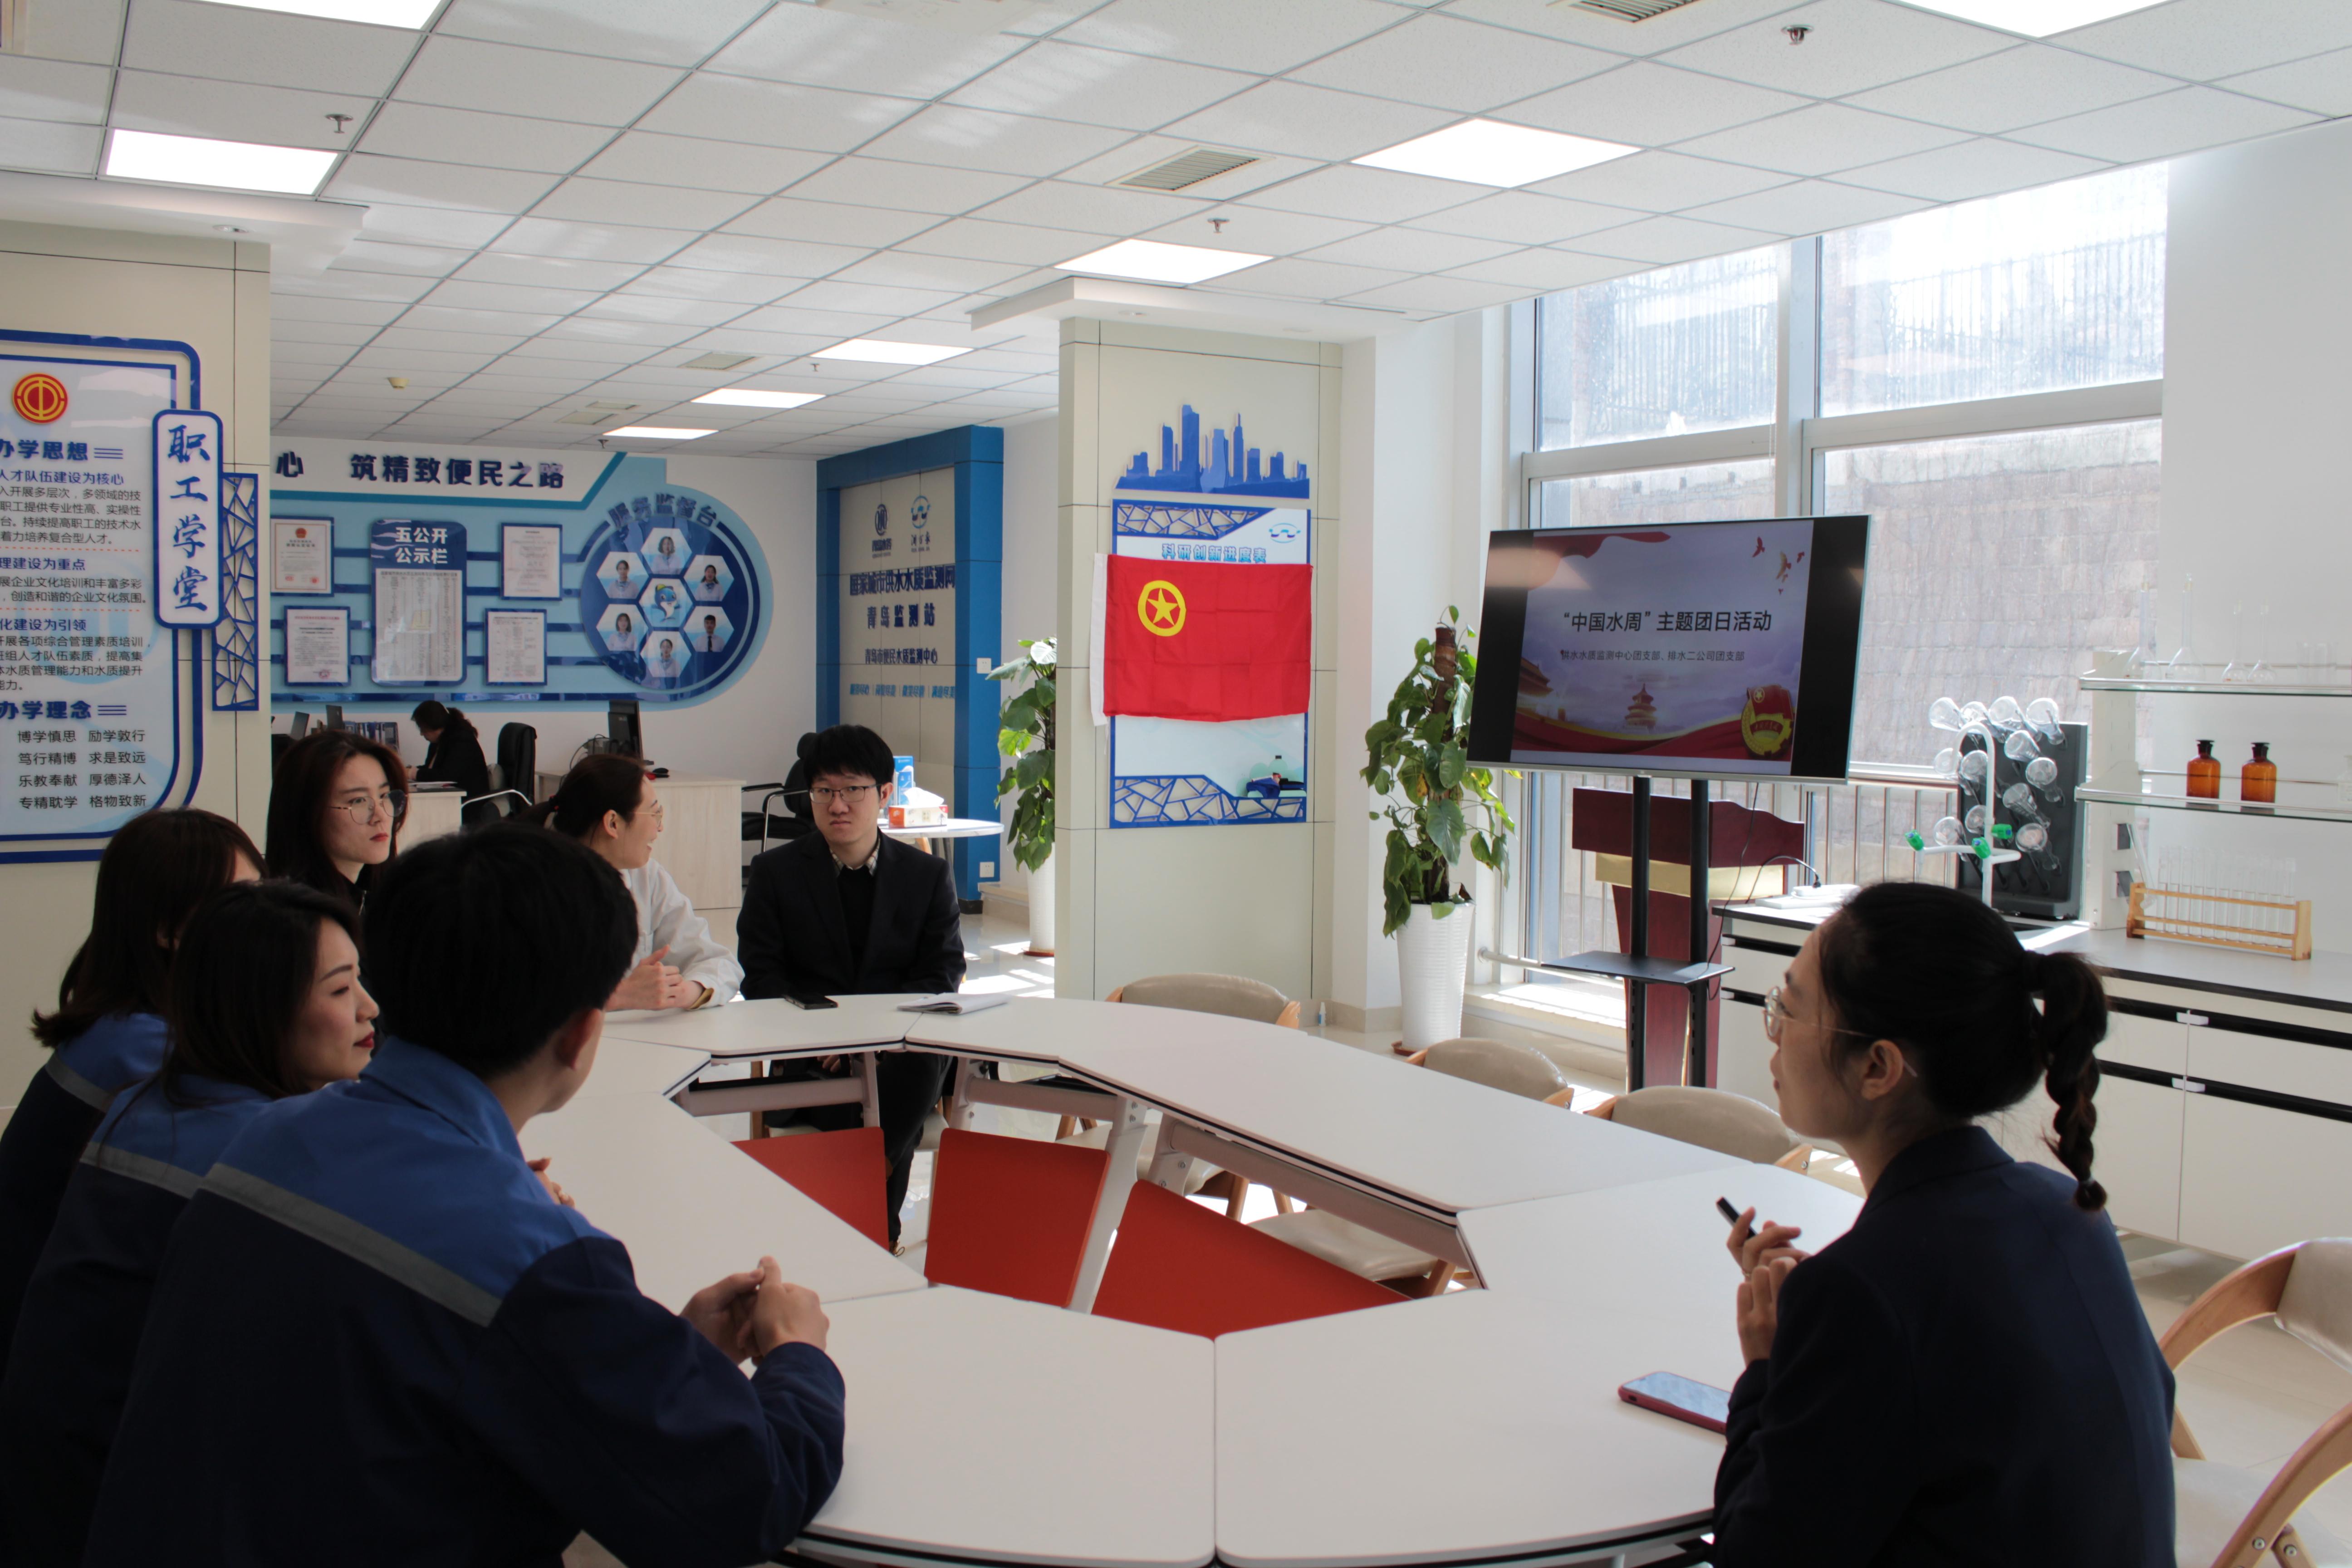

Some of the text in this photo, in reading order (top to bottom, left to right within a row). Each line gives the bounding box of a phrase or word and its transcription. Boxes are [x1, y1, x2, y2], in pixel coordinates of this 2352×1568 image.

[0, 439, 88, 461] 办学思想
[0, 469, 124, 485] 人才队伍建设为核心
[275, 451, 564, 489] 心 筑精致便民之路
[0, 501, 141, 516] 职工提供专业性高、实操性
[167, 424, 211, 612] 职工学堂
[0, 531, 112, 544] 着力培养复合型人才。
[395, 527, 448, 544] 五公开
[395, 547, 448, 564] 公示栏
[1162, 544, 1266, 564] 科研创新进度表
[850, 565, 956, 596] 国家城市供水水质监测网
[867, 602, 935, 629] 青岛监测站
[1563, 610, 1772, 632] “中国水周”主题团日活动
[0, 618, 87, 632] 化建设为引领
[865, 647, 938, 664] 青岛市便民水质监测中心
[1561, 650, 1745, 662] 供水水质监测中心团支部、排水二公司团支部
[0, 701, 91, 720] 办学理念
[18, 730, 145, 743] 博学慎思 励学敦行
[18, 751, 146, 765] 笃行精博 求是致远
[19, 773, 147, 787] 乐教奉献 厚德泽人
[20, 794, 147, 809] 专精耽学 格物致新
